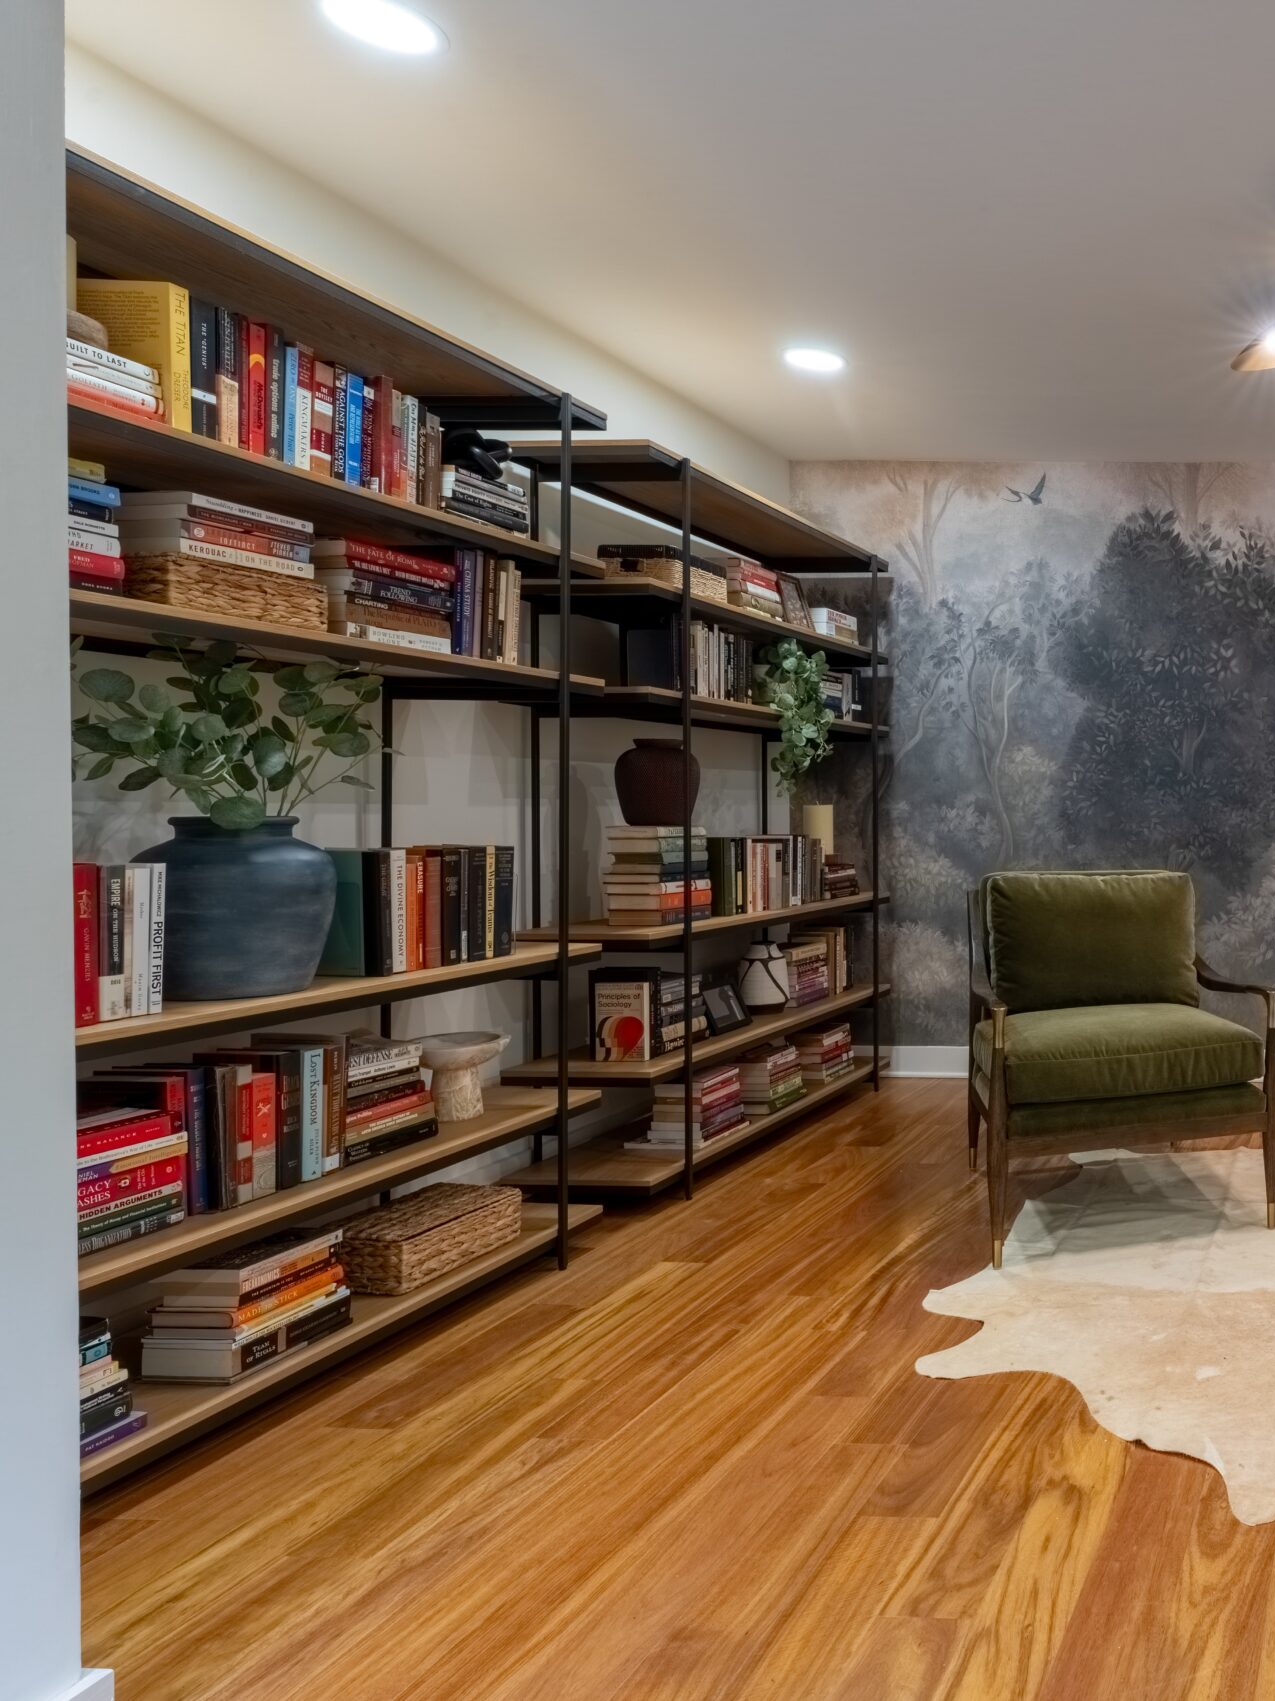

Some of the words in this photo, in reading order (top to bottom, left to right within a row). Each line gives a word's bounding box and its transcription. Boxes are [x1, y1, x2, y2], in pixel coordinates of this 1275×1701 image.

[175, 292, 186, 316] THE
[176, 322, 187, 357] TITAN
[92, 350, 103, 360] TO
[106, 355, 127, 368] LAST
[272, 359, 281, 379] trade
[270, 382, 280, 412] options
[270, 414, 280, 439] online
[288, 413, 296, 431] Peter
[300, 394, 309, 458] KINGMAKERS
[205, 498, 234, 511] Stumbling
[238, 508, 262, 519] HAPPINESS
[68, 539, 94, 551] ARKET
[188, 544, 227, 558] KEROUAC
[245, 555, 255, 564] ON
[258, 558, 273, 567] THE
[276, 561, 295, 572] ROAD
[351, 545, 365, 554] THE
[367, 548, 384, 559] FATE
[385, 551, 395, 561] OF
[397, 556, 416, 567] ROME
[464, 570, 472, 593] CHINA
[380, 591, 418, 604] FOLLOWING
[389, 586, 411, 597] TREND
[354, 598, 389, 610] CHARTING
[372, 630, 405, 641] BOWLING
[110, 878, 121, 906] EMPIRE
[112, 908, 119, 919] ON
[112, 935, 120, 962] HUDSON
[152, 921, 164, 961] PROFIT
[151, 964, 162, 996] FIRST
[597, 993, 632, 1003] Principles
[632, 992, 641, 1000] of
[597, 1001, 632, 1010] Sociology
[361, 1047, 394, 1066] DEFENSE
[96, 1131, 137, 1146] BALANCE
[78, 1170, 94, 1179] NIEL
[78, 1179, 112, 1197] GACY
[77, 1190, 111, 1207] ASHES
[79, 1205, 111, 1221] HIDDEN
[113, 1189, 163, 1209] ARGUMENTS
[129, 1208, 146, 1217] Financial
[237, 1307, 262, 1323] MADE
[273, 1290, 299, 1307] STICK
[252, 1340, 270, 1354] TEAM
[254, 1345, 277, 1360] RIVALS
